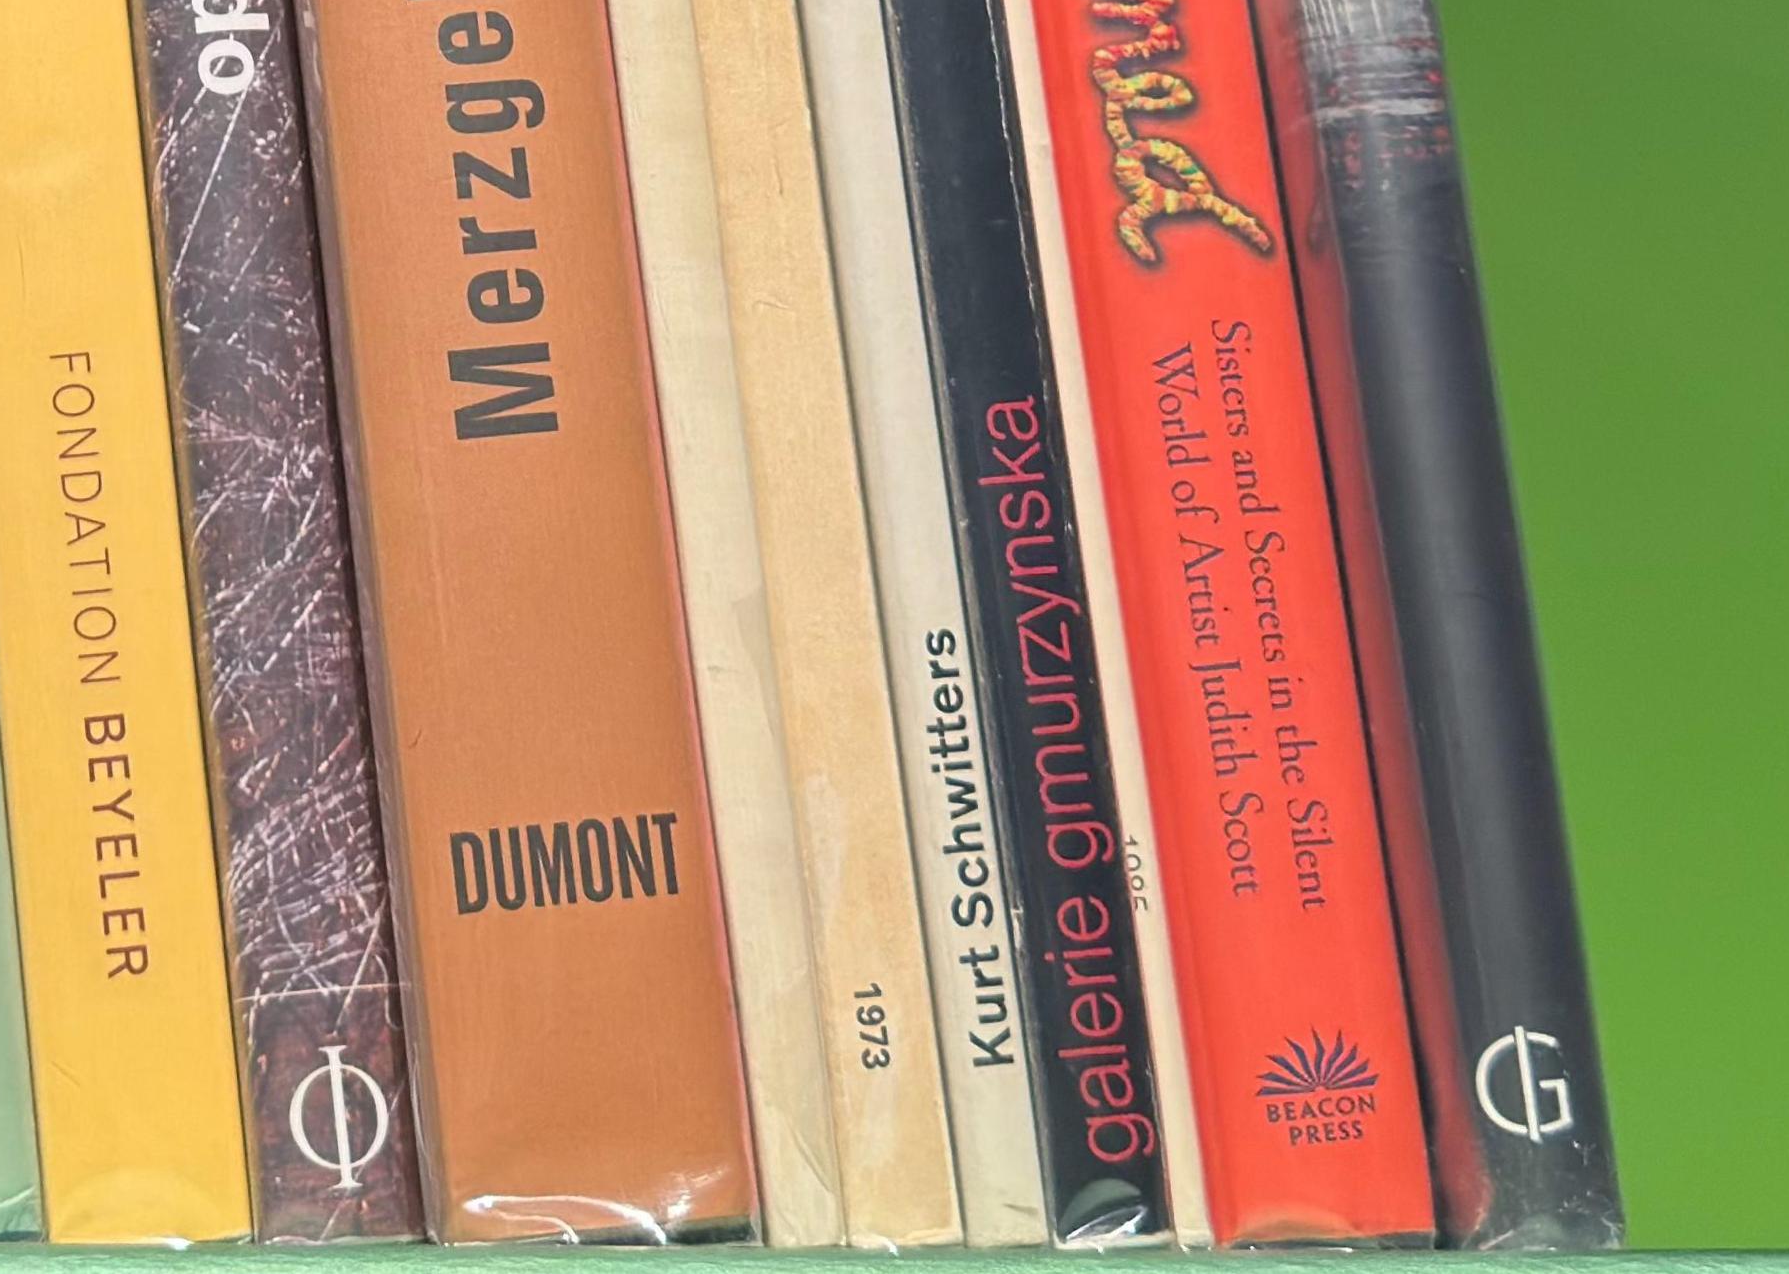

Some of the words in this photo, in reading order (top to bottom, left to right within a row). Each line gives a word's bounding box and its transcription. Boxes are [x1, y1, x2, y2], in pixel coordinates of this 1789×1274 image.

[1152, 342, 1208, 467] World
[1209, 319, 1253, 436] Sisters
[48, 353, 121, 686] FONDATION
[1175, 480, 1218, 524] of
[1233, 451, 1281, 514] and
[978, 396, 1115, 870] gmurzynska
[1178, 534, 1229, 647] Artist
[1244, 530, 1293, 661] Secrets
[1187, 658, 1256, 777] Judith
[1267, 677, 1306, 711] in
[926, 629, 995, 928] Schwitters
[1274, 725, 1318, 786] the
[83, 714, 150, 980] BEYELER
[450, 812, 679, 915] DUMONT
[1219, 792, 1266, 896] Scott
[1286, 799, 1333, 910] Silent
[852, 983, 891, 1070] 1973
[958, 948, 1015, 1069] Kurt
[1043, 896, 1156, 1164] galerie
[1266, 1092, 1376, 1124] BEACON
[1289, 1119, 1365, 1146] PRESS
